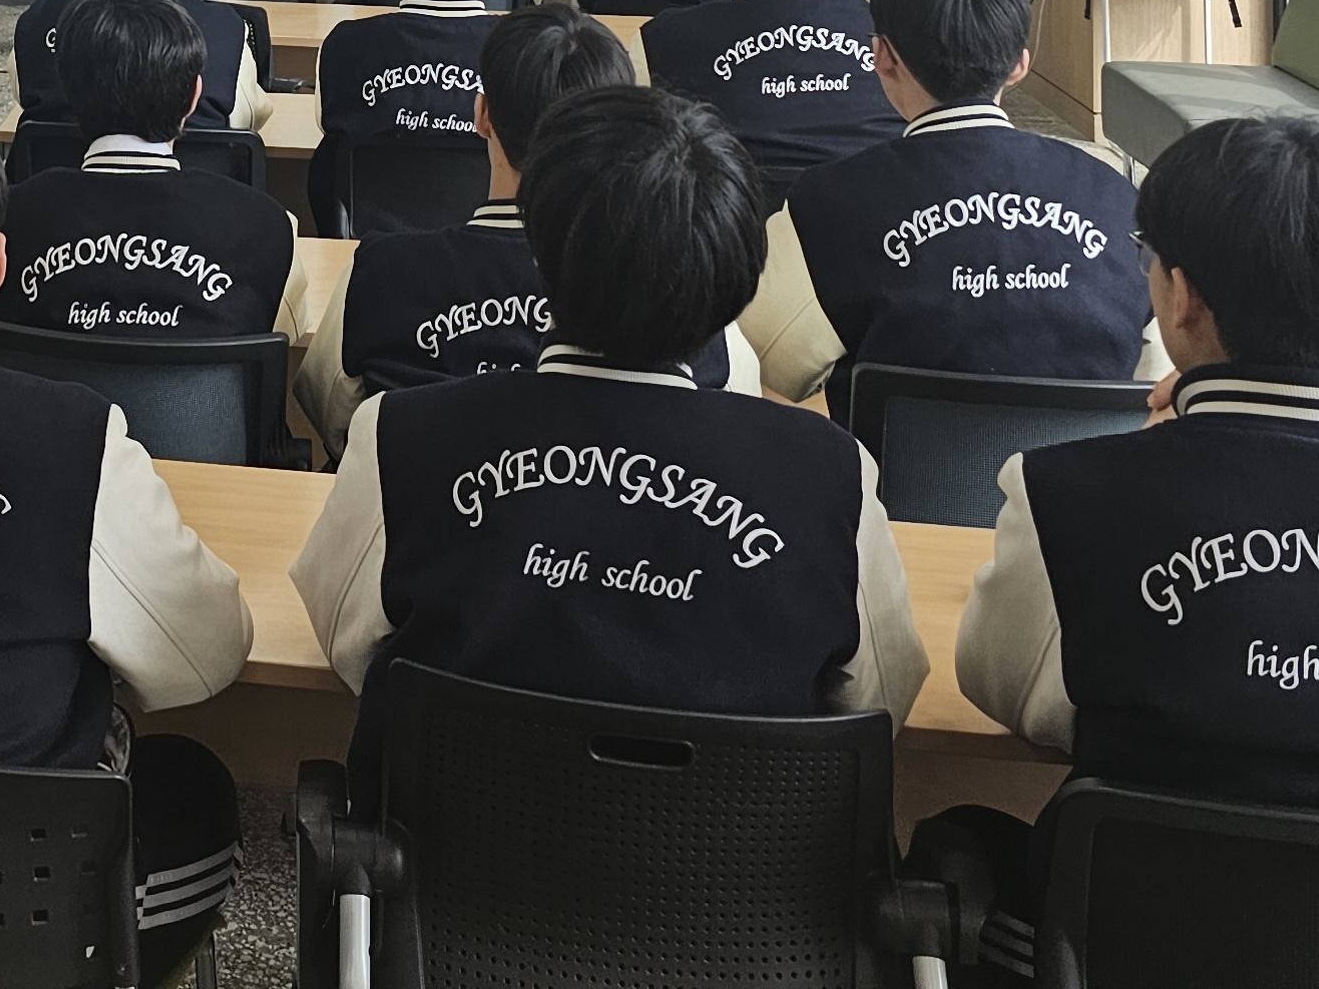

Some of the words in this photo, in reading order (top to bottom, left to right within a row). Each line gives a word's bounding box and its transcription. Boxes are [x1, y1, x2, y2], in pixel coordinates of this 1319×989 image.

[713, 24, 876, 82] GYEONGSANG
[362, 62, 485, 107] GYEONGS
[761, 74, 797, 99] high
[799, 72, 852, 92] school
[395, 107, 429, 131] high
[431, 113, 477, 133] schoo
[883, 191, 1109, 268] GYEONGSANG
[21, 233, 233, 302] GYEONGSANG
[952, 265, 1000, 298] high
[1003, 263, 1072, 290] school
[67, 301, 112, 330] high
[115, 302, 183, 328] school
[416, 294, 552, 358] GYEONG
[452, 445, 785, 570] GYEONGSANG
[523, 543, 590, 589] high
[600, 558, 703, 602] school
